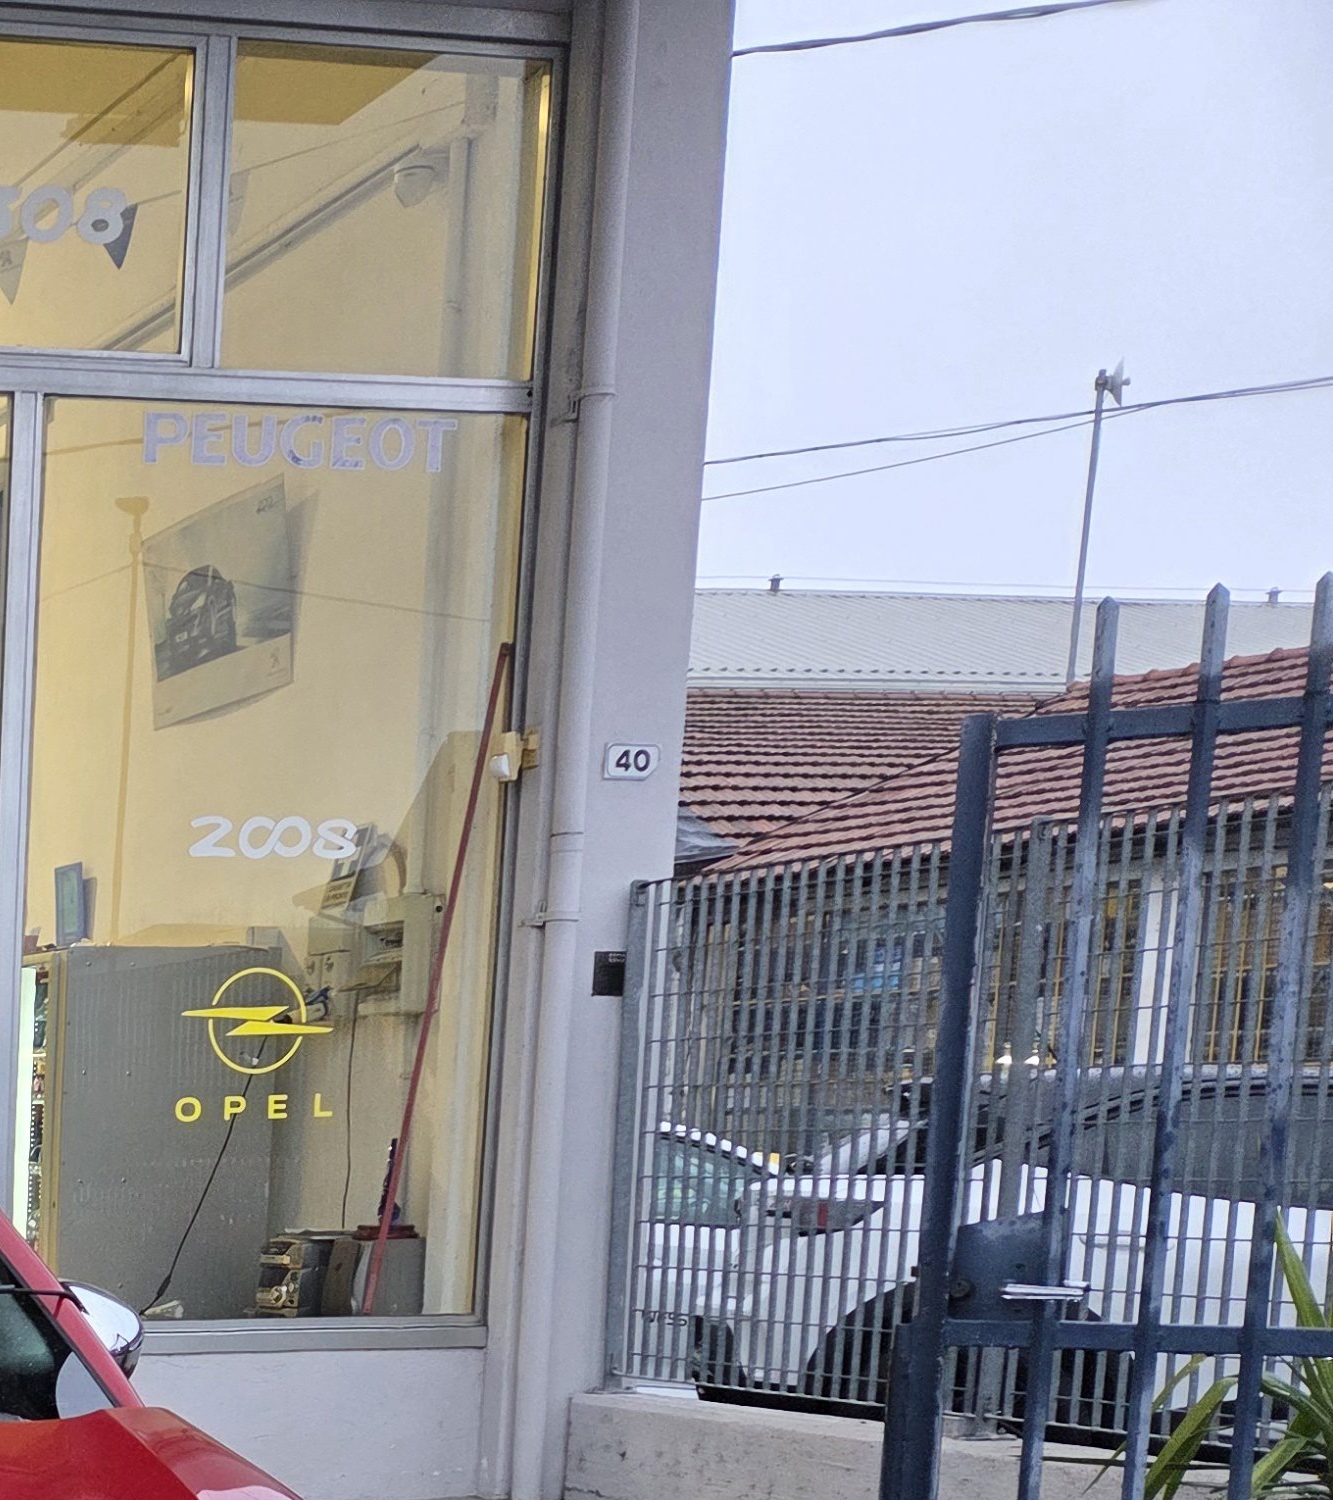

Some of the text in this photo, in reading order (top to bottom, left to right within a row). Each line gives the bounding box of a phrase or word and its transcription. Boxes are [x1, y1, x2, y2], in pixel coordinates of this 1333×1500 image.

[143, 412, 458, 473] PEUGEOT
[614, 749, 652, 773] 40
[188, 815, 358, 860] 2008
[175, 1093, 334, 1123] OPEL
